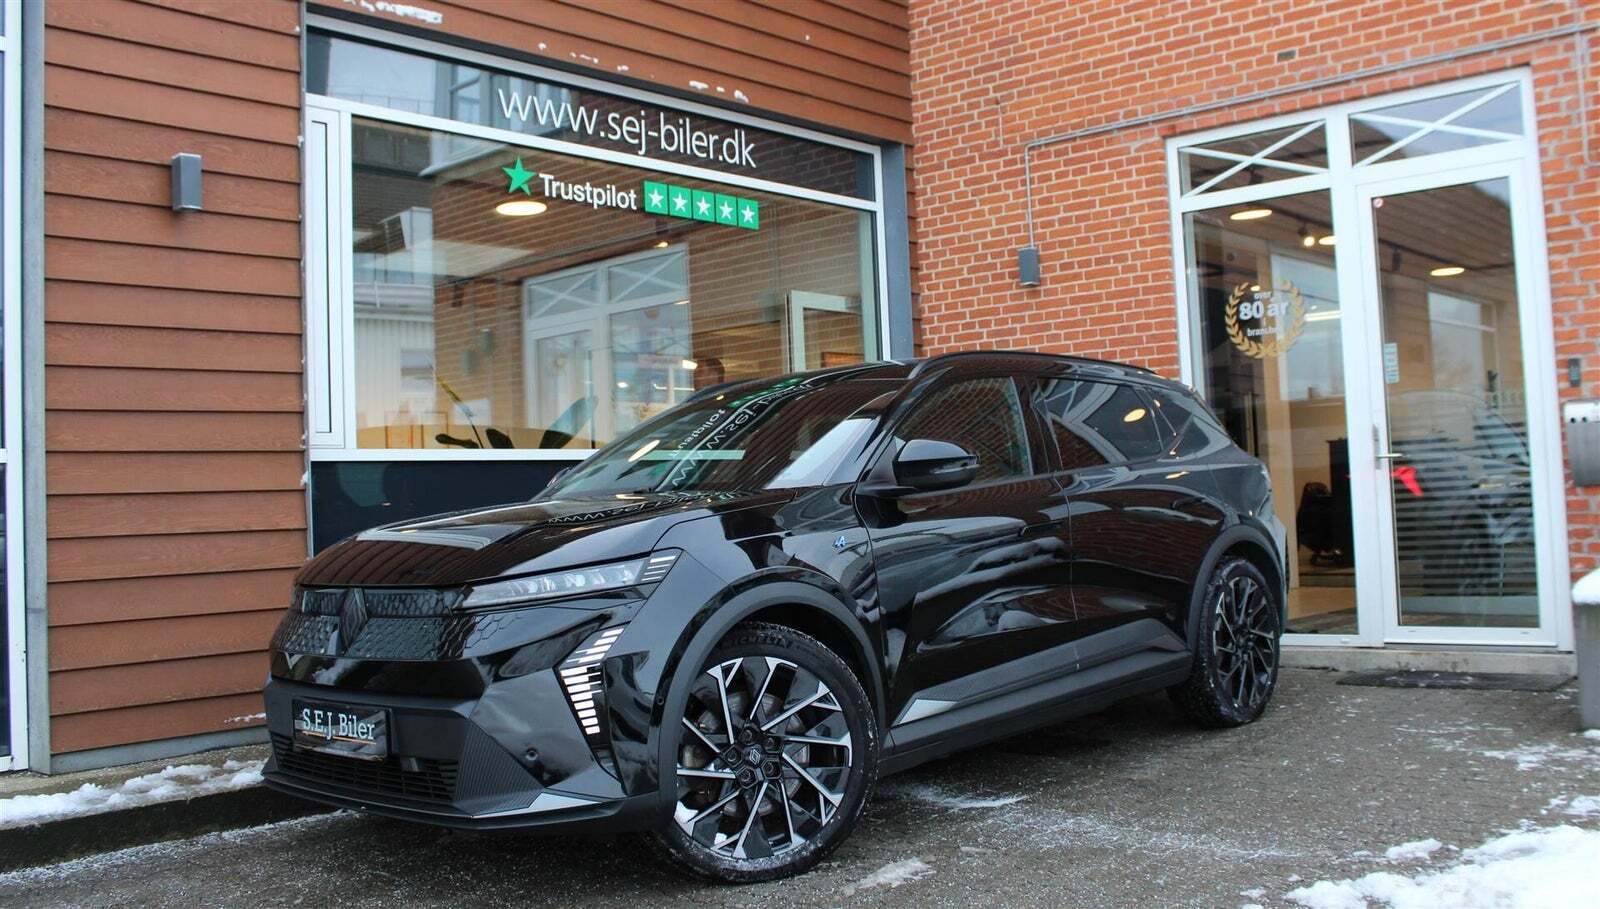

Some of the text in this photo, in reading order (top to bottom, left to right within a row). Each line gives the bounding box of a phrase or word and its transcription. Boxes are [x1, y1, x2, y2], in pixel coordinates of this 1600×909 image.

[498, 88, 757, 168] www.sej-biler.dk
[539, 173, 637, 210] Trustpilot
[1239, 300, 1264, 320] 80
[302, 708, 375, 740] S.E.J. Biler
